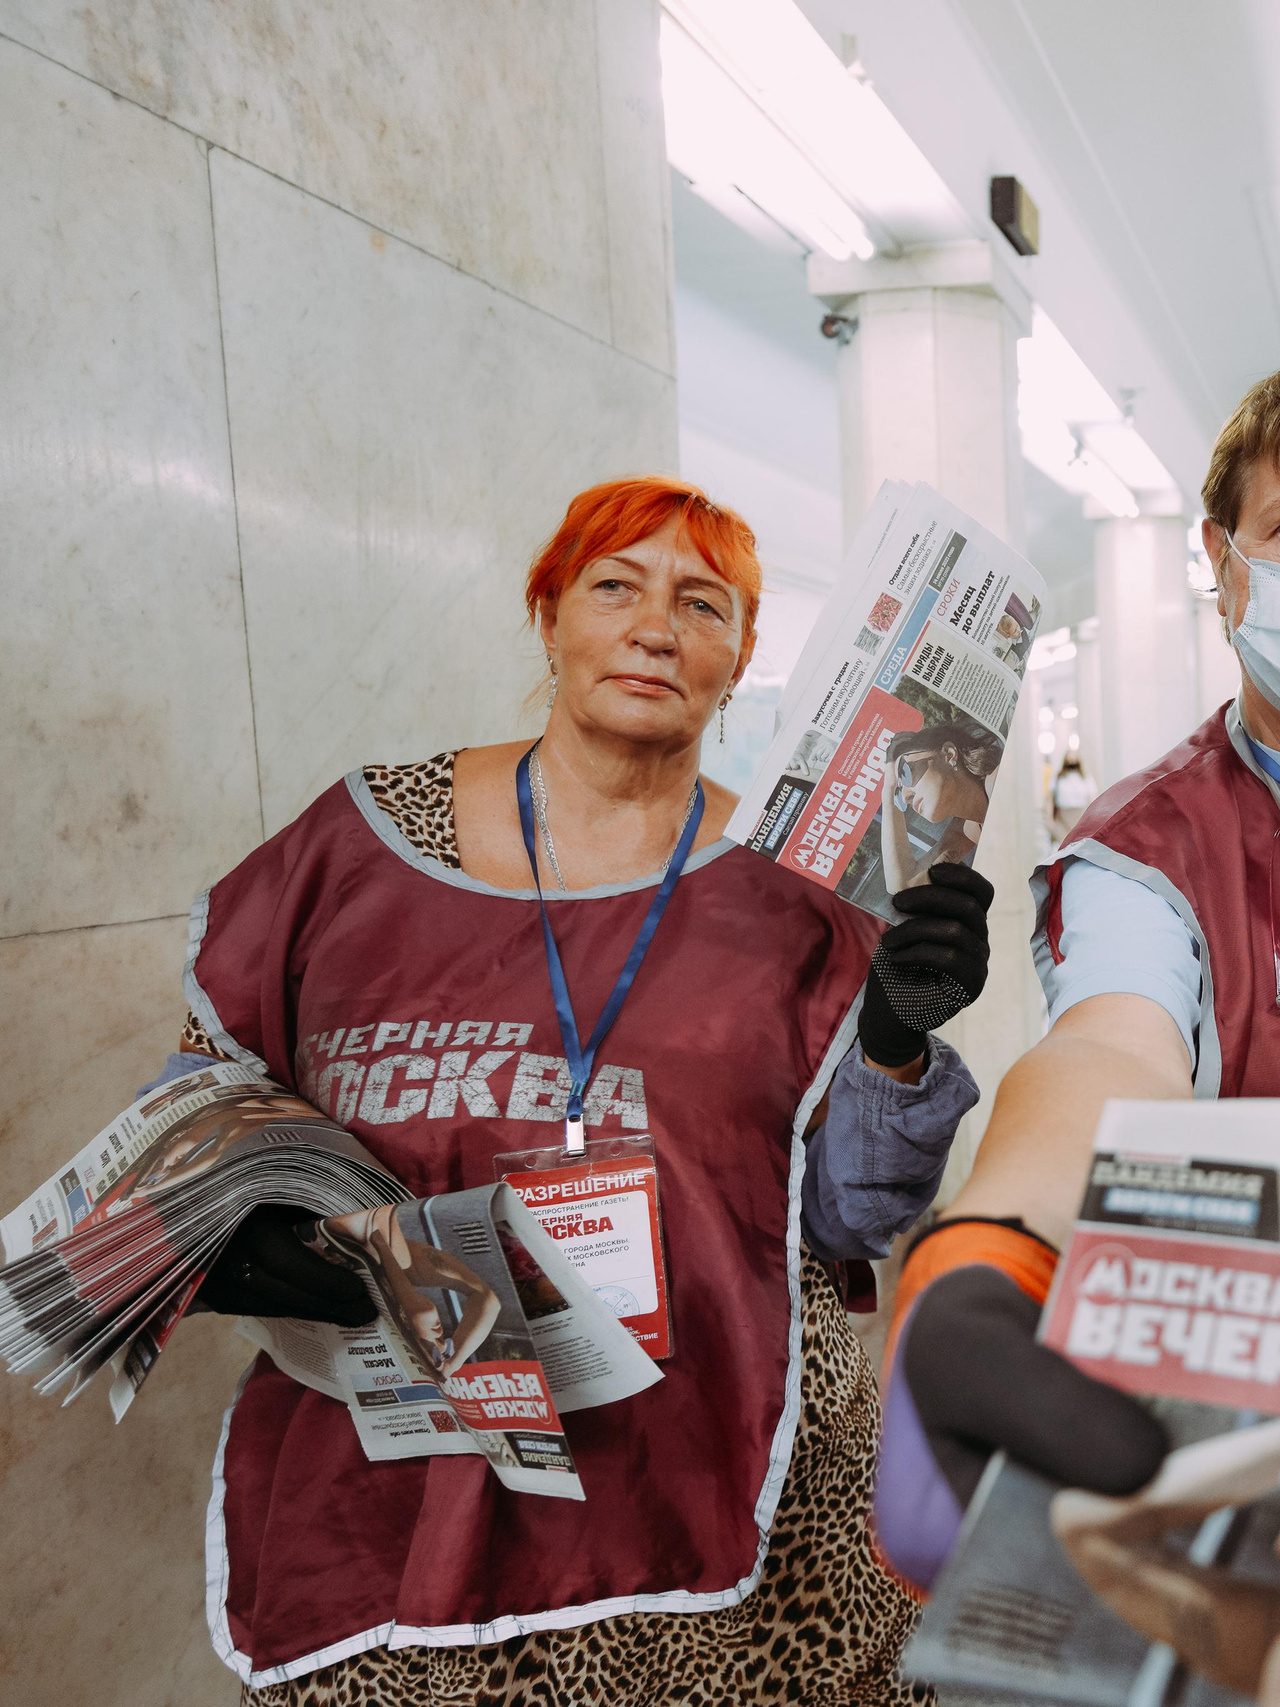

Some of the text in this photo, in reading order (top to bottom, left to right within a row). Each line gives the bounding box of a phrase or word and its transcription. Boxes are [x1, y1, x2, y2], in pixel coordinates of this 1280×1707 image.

[887, 532, 920, 585] Отдам всего себя
[896, 520, 938, 590] Самые бескорыстные
[904, 574, 917, 594] знаки
[914, 548, 932, 575] зодиака
[935, 578, 961, 616] СРОКИ
[948, 584, 977, 626] Месяц
[960, 570, 996, 633] до выплат
[879, 643, 908, 685] СРЕДА
[911, 642, 935, 675] НАРЯДЫ
[921, 645, 945, 681] ВЫБРАЛИ
[931, 652, 956, 687] ПОПРОЩЕ
[810, 689, 834, 724] Закусочка
[833, 660, 850, 686] грядки
[819, 658, 863, 729] Готовим вкуснятину
[826, 723, 835, 733] из
[831, 697, 850, 724] свежих
[846, 669, 866, 698] овощей
[750, 782, 793, 851] ПАНДЕМИЯ
[765, 790, 801, 846] БЕРЕГИ СЕБЯ
[792, 780, 848, 867] МОСКВА
[308, 1051, 649, 1130] ОСКВА
[538, 1213, 583, 1227] ЕРНЯЯ
[564, 1244, 594, 1254] ГОРОДА
[573, 1245, 629, 1260] МОСКОВСКОГО
[481, 1401, 548, 1419] МОСКВА
